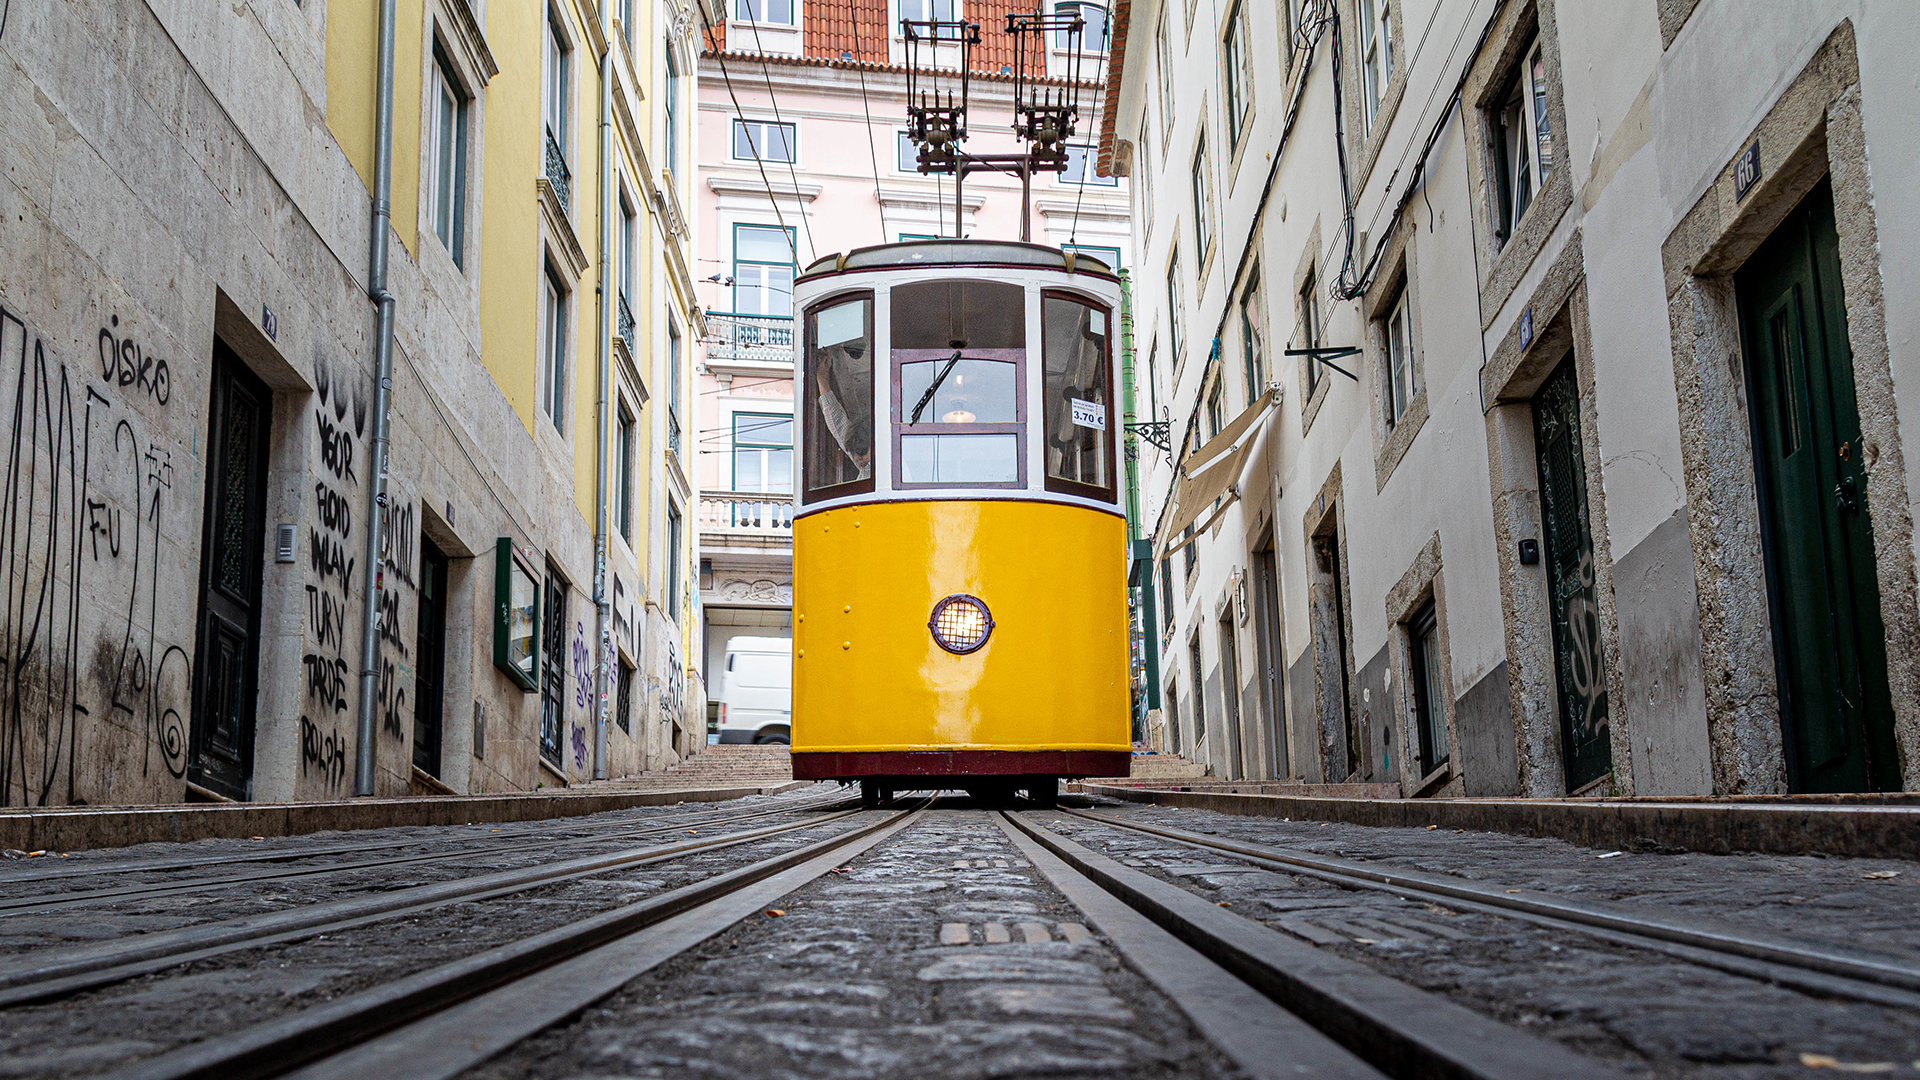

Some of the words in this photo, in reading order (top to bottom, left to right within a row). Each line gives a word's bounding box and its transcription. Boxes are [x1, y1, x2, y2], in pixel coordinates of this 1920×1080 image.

[1737, 150, 1755, 192] 66
[1073, 410, 1095, 423] 3.70
[1097, 416, 1104, 425] €
